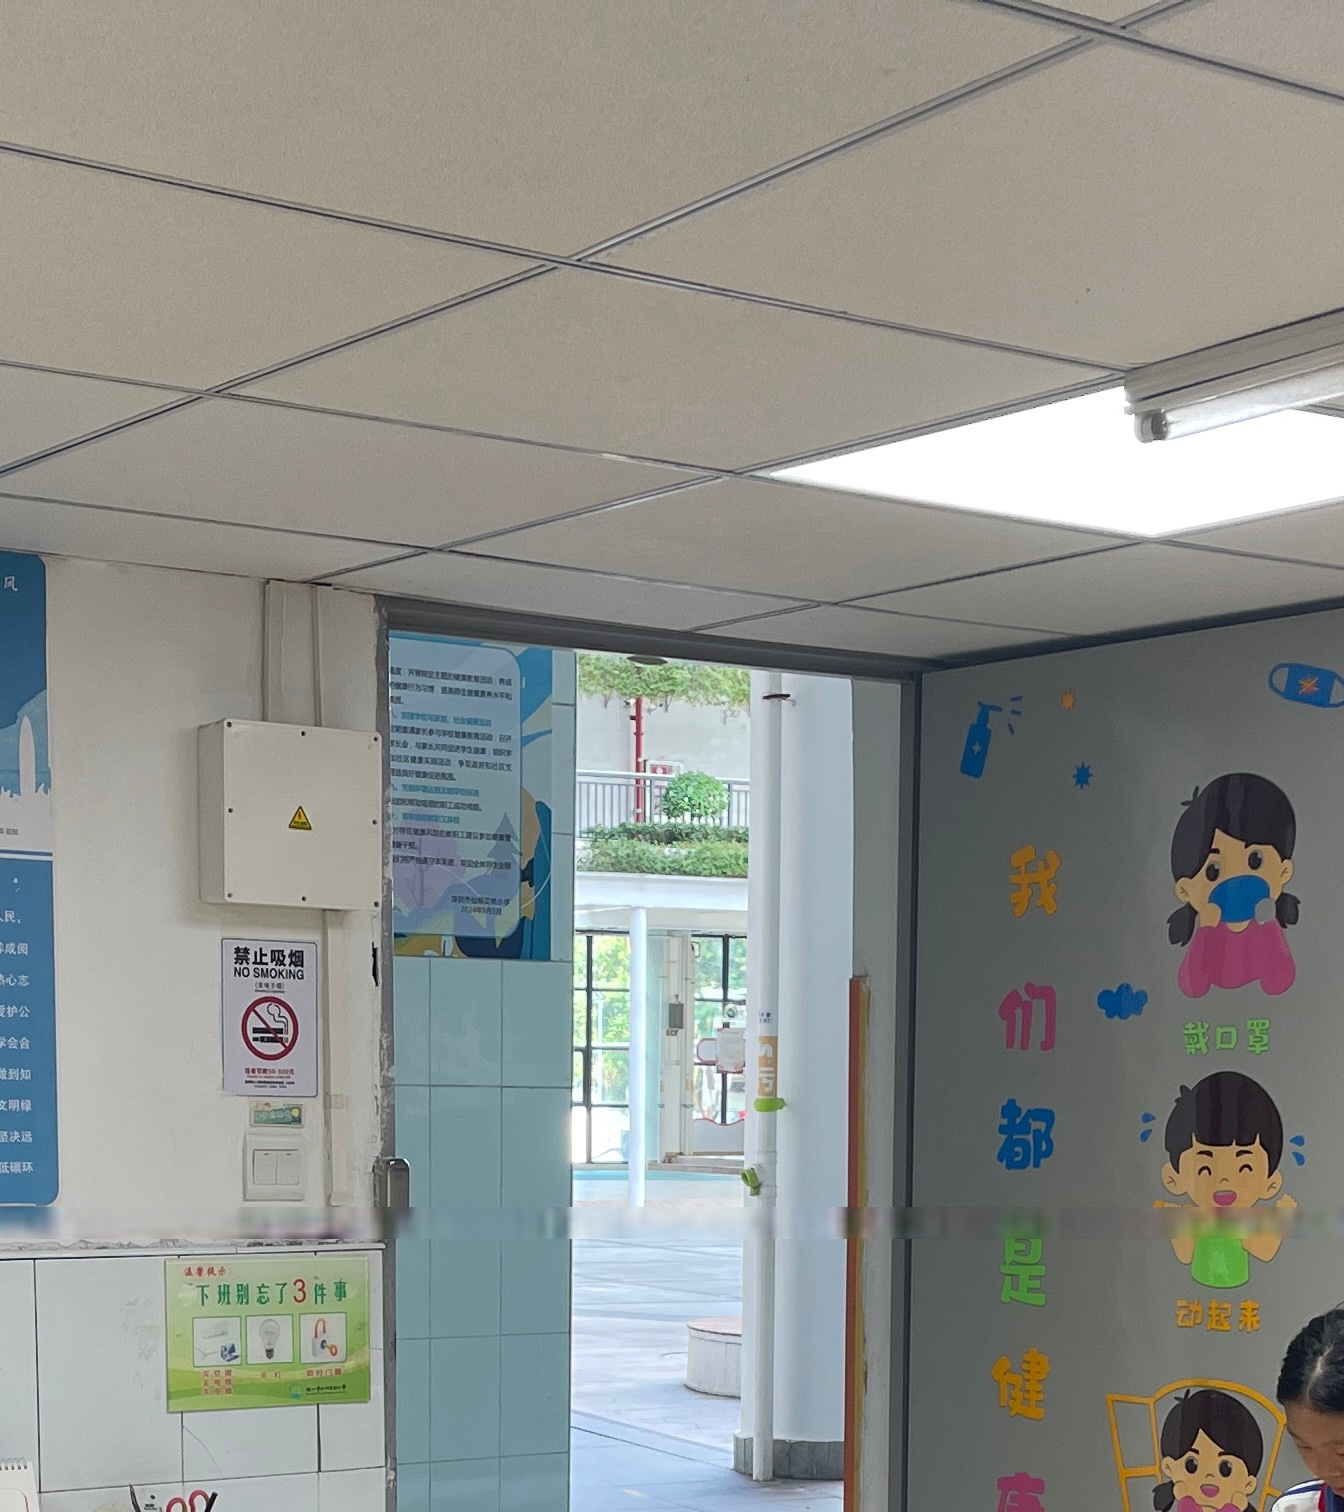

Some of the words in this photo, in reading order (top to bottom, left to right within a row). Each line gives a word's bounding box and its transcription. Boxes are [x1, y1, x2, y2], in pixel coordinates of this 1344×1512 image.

[234, 946, 304, 968] 禁止吸烟
[234, 967, 250, 978] NO
[253, 968, 304, 980] SMOKING
[1183, 1018, 1271, 1056] 戴口罩
[1175, 1299, 1261, 1333] 动起来
